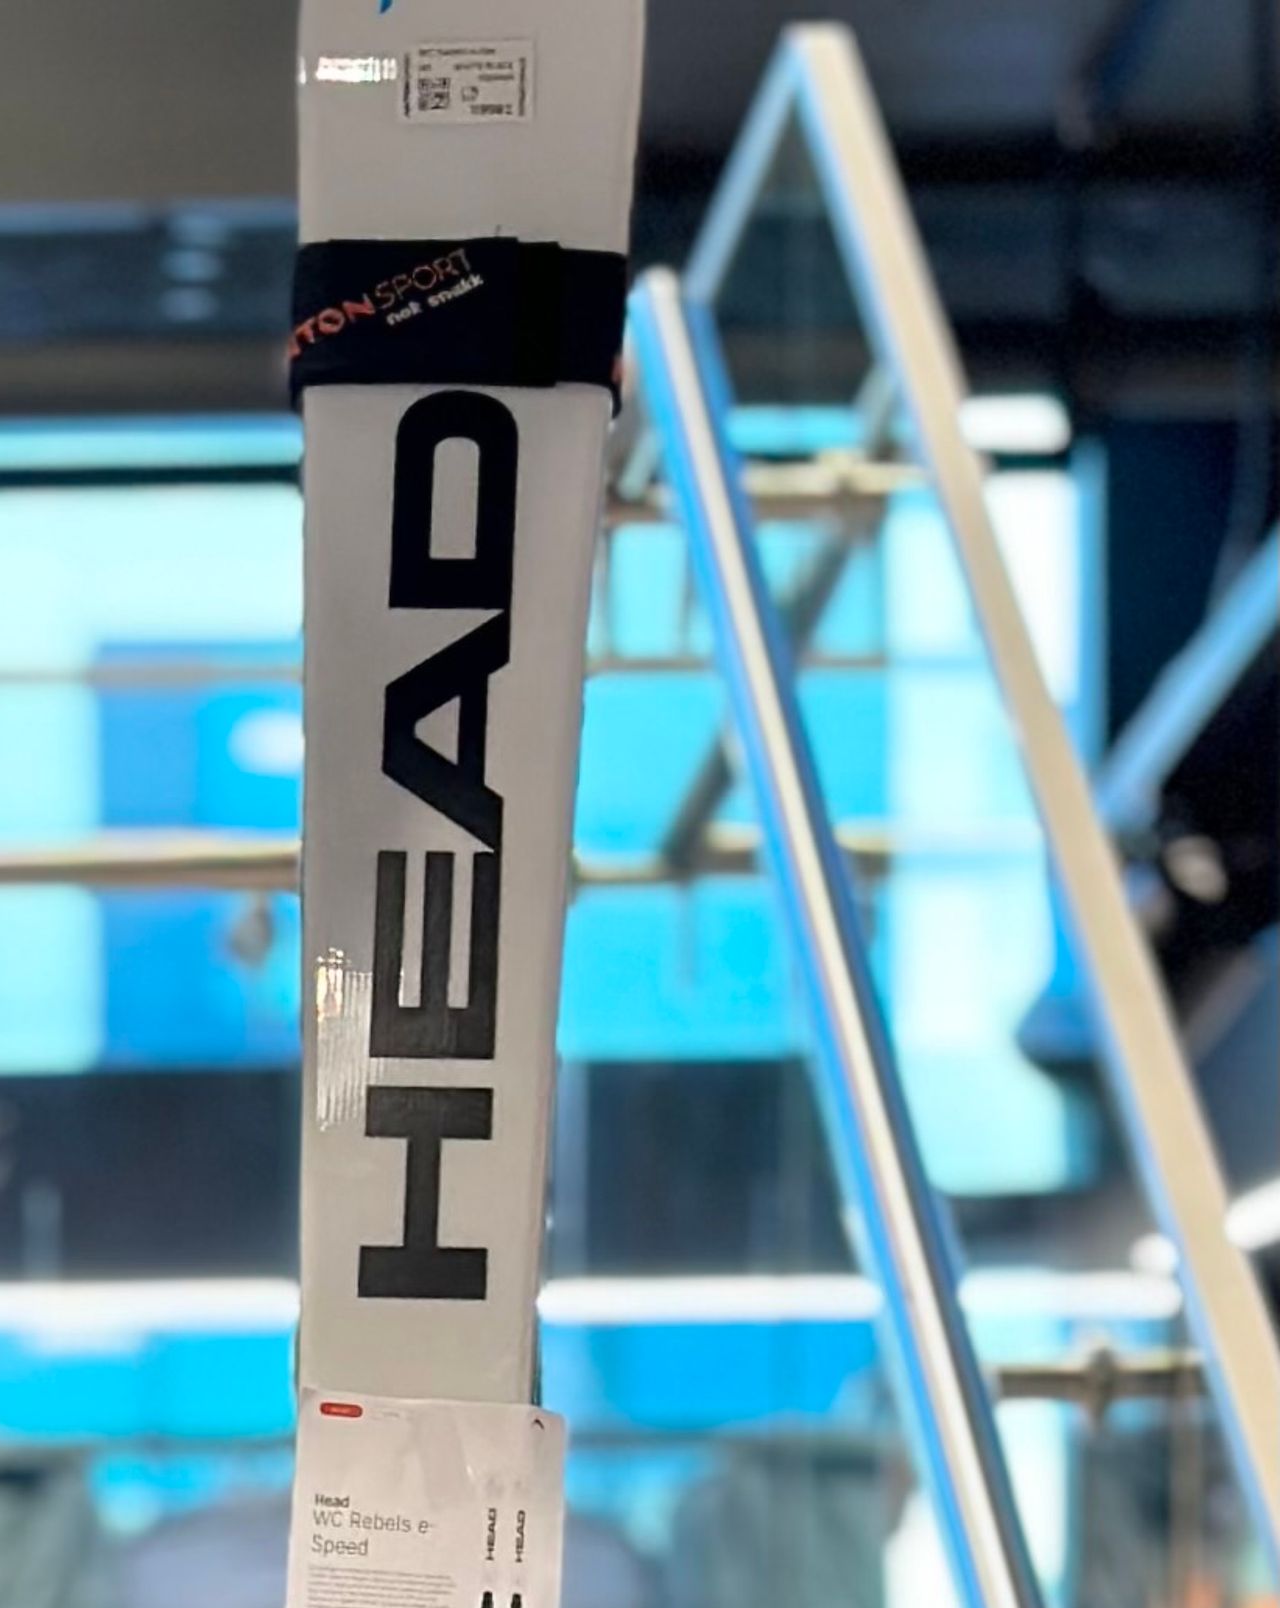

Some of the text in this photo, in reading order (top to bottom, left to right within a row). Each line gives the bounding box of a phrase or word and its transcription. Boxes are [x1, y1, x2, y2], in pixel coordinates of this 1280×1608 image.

[357, 390, 519, 1299] HEAD
[314, 1493, 350, 1508] Head
[313, 1509, 344, 1528] WC
[349, 1511, 412, 1533] Rebels
[311, 1533, 369, 1557] Speed
